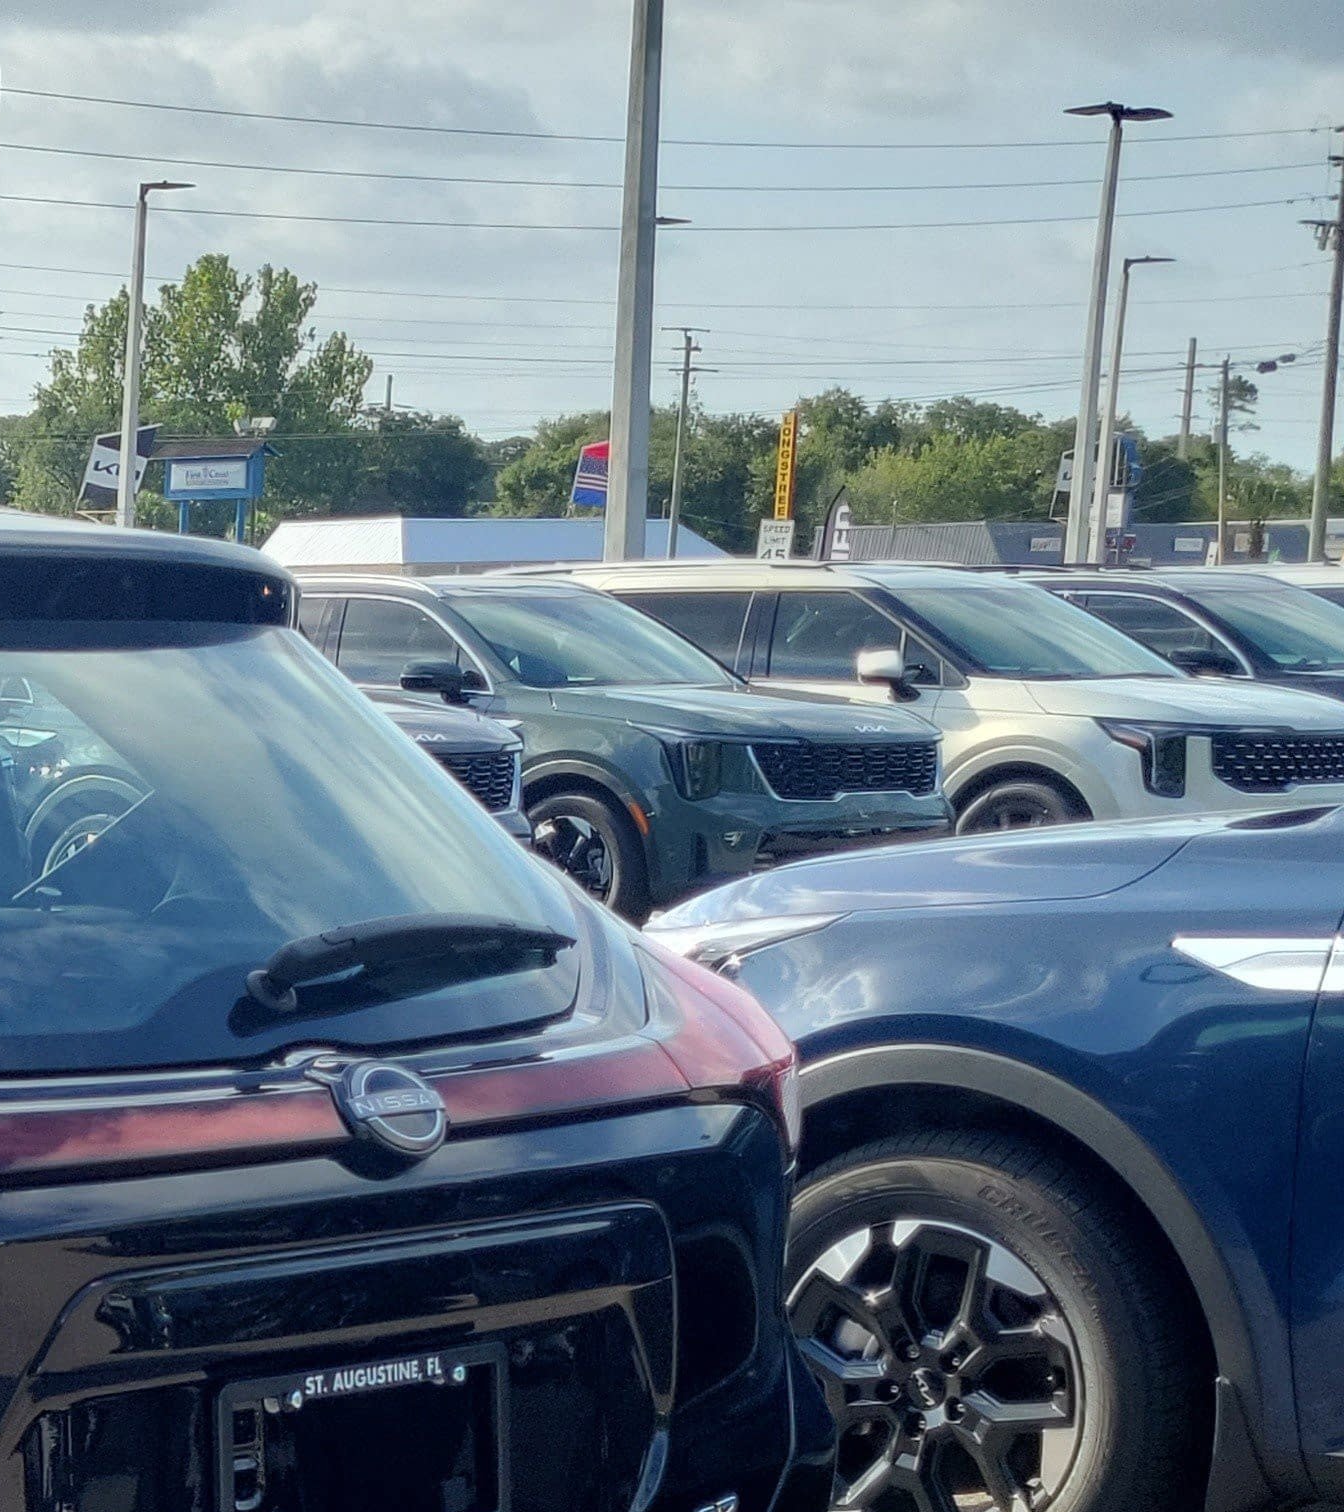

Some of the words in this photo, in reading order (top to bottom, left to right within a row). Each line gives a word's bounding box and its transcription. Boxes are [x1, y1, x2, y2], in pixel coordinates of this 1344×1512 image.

[763, 525, 791, 534] SPEED
[304, 1376, 328, 1395] ST.
[332, 1360, 425, 1393] AUGUSTINE,
[427, 1356, 442, 1376] FL
